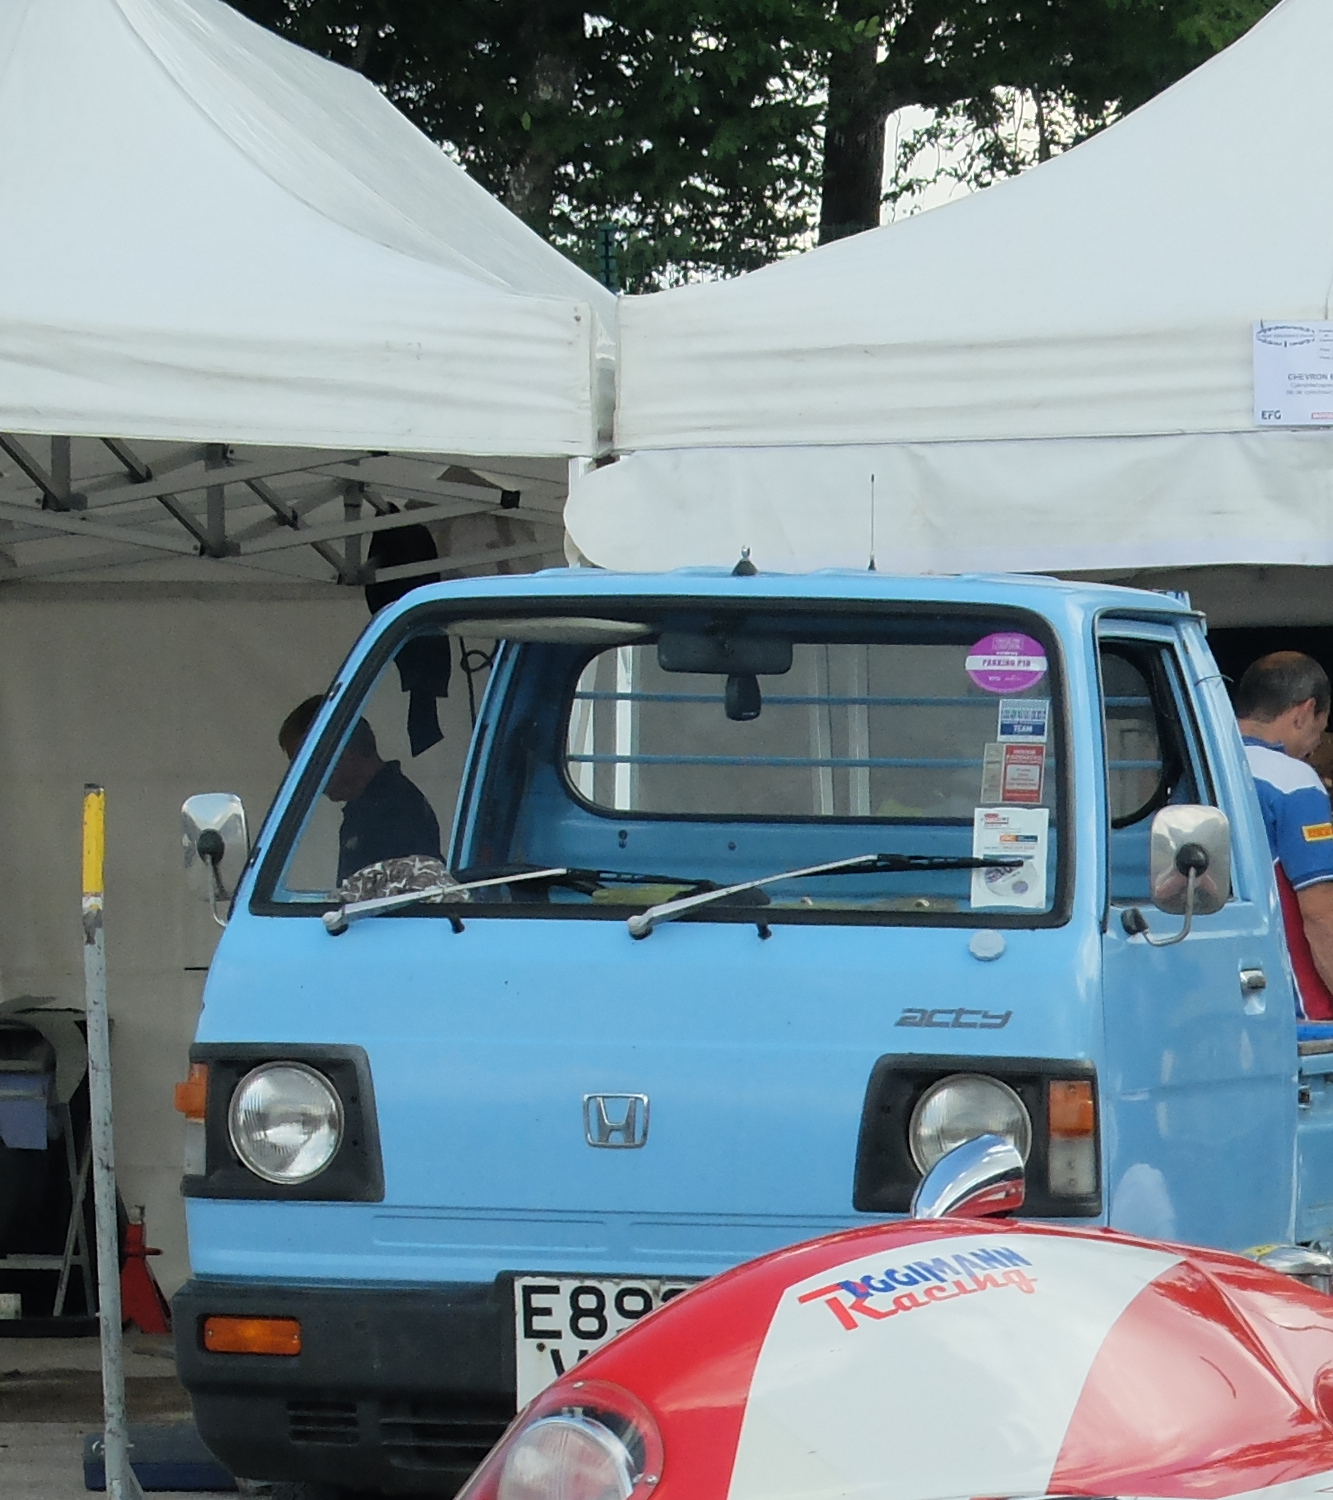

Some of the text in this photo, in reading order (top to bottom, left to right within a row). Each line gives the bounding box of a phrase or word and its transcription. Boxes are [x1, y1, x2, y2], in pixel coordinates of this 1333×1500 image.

[1261, 410, 1282, 420] EFG
[522, 1284, 688, 1340] E89
[797, 1269, 1038, 1331] Racing
